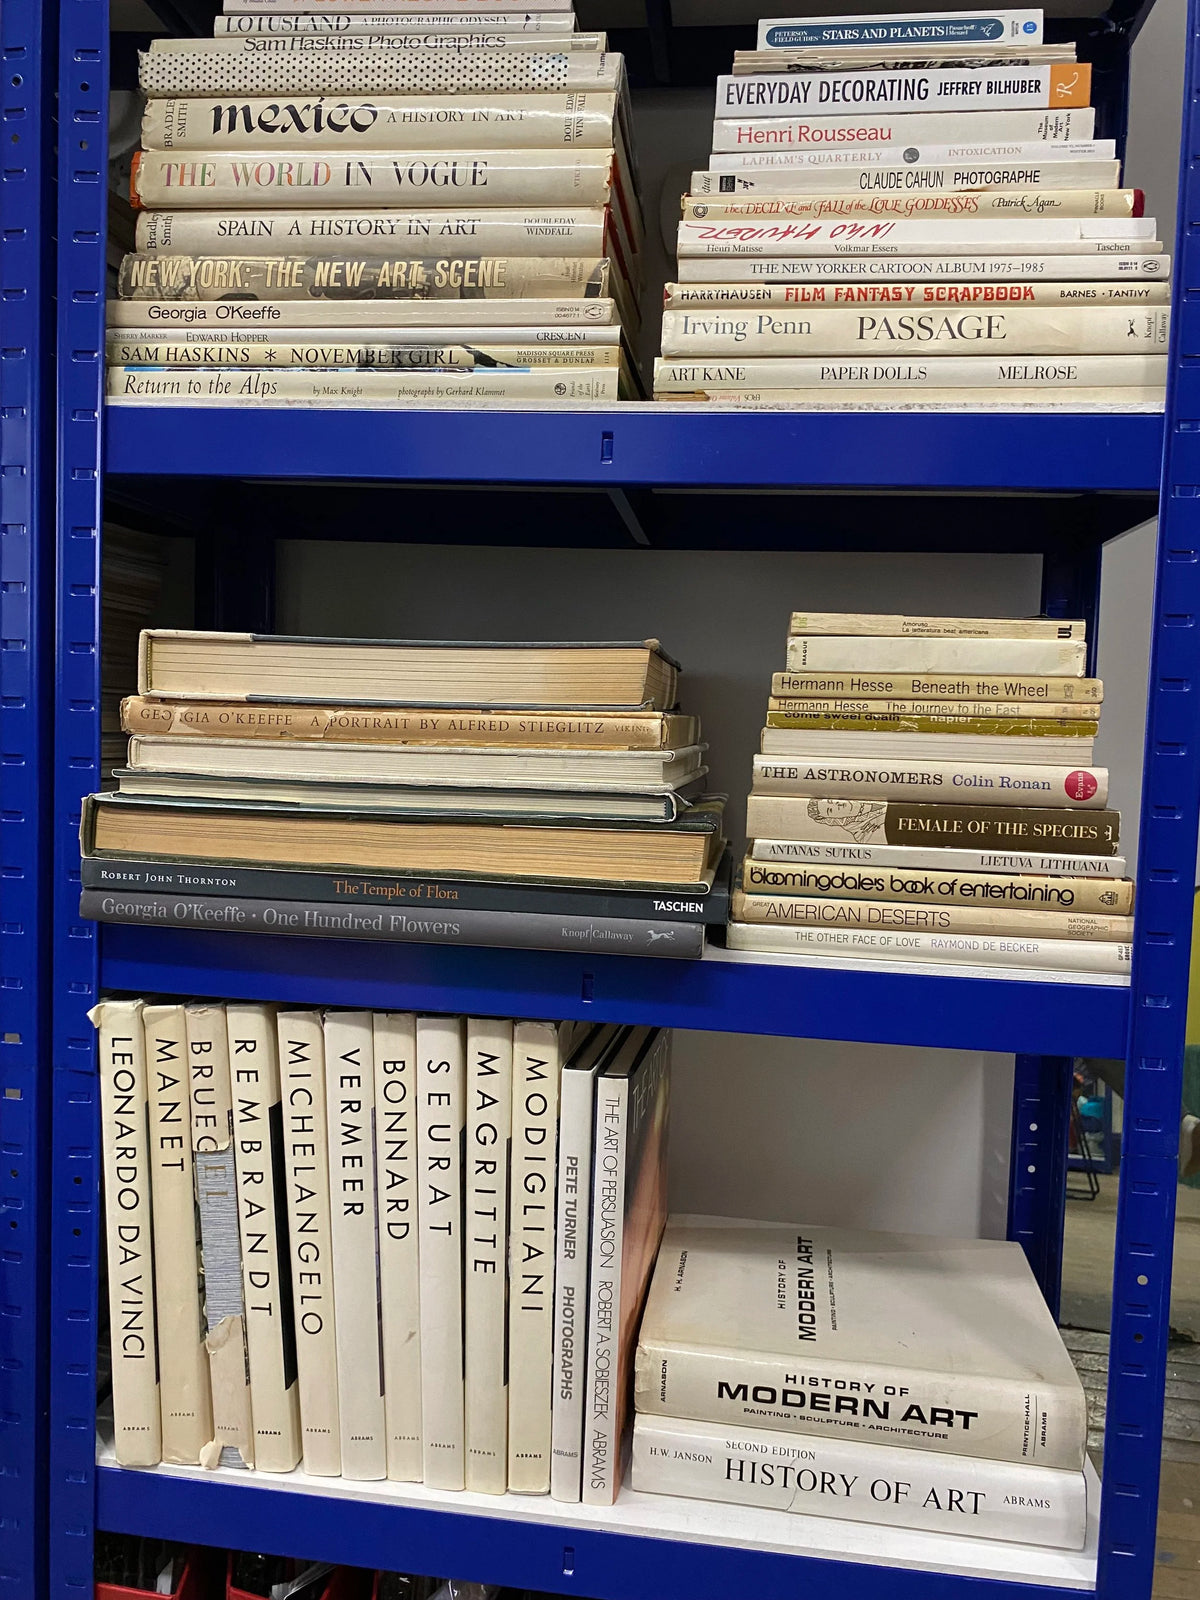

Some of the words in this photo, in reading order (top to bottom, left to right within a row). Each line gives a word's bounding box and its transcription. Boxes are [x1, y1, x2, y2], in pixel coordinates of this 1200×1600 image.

[822, 29, 859, 41] STARS
[861, 28, 887, 39] AND
[889, 26, 945, 38] PLANETS
[726, 80, 811, 105] EVERYDAY
[818, 78, 929, 103] DECORATING
[937, 80, 983, 96] JEFFREY
[986, 79, 1041, 95] BILHUBER
[737, 126, 793, 144] Henri
[798, 125, 892, 143] Rousseau
[948, 147, 1022, 157] INTOXICATION
[160, 161, 216, 187] THE
[231, 161, 332, 187] WORLD
[344, 160, 374, 187] IN
[392, 160, 488, 187] VOGUE
[859, 171, 903, 190] CLAUDE
[905, 171, 944, 189] CAHUN
[953, 170, 1041, 185] PHOTOGRAPHE
[834, 244, 870, 253] Volkmar
[872, 244, 898, 253] Essers
[1095, 243, 1130, 252] Taschen
[130, 260, 182, 287] NEW
[188, 260, 251, 288] YORK:
[264, 260, 307, 288] THE
[314, 260, 367, 288] NEW
[377, 260, 424, 288] ART
[434, 259, 508, 288] SCENE
[681, 289, 772, 300] HARRYHAUSEN
[785, 287, 826, 302] FILM
[834, 286, 916, 302] FANTASY
[923, 286, 1035, 303] SCRAPBOOK
[1060, 289, 1097, 298] BARNES
[1109, 288, 1150, 298] TANTIVY
[148, 305, 207, 322] Georgia
[215, 304, 281, 320] O'Keeffe
[186, 332, 228, 343] EDWARD
[230, 332, 270, 344] HOPPER
[682, 315, 748, 342] Irving
[756, 315, 812, 335] Penn
[856, 315, 1007, 341] PASSAGE
[121, 347, 160, 363] SAM
[165, 347, 251, 364] HASKINS
[290, 349, 402, 364] NOVEMBER
[408, 350, 460, 365] GIRL
[123, 374, 182, 395] Return
[187, 377, 202, 394] to
[214, 374, 233, 394] the
[239, 374, 279, 398] Alps
[780, 677, 844, 692] Hermann
[850, 677, 893, 693] Hesse
[911, 679, 971, 695] Beneath
[976, 680, 999, 695] the
[1004, 682, 1049, 697] Wheel
[219, 711, 293, 726] O'KEEFFE
[310, 716, 320, 727] A
[329, 716, 410, 730] PORTRAIT
[419, 719, 440, 731] BY
[448, 719, 510, 732] ALFRED
[519, 720, 605, 734] STIEGLITZ
[761, 766, 798, 778] THE
[803, 768, 944, 786] ASTRONOMERS
[952, 774, 994, 788] Colin
[998, 776, 1052, 791] Ronan
[1075, 772, 1084, 799] Evans
[898, 817, 962, 833] FEMALE
[967, 820, 991, 833] OF
[994, 821, 1028, 836] THE
[1033, 823, 1098, 839] SPECIES
[769, 845, 820, 857] ANTANAS
[825, 847, 872, 860] SUTKUS
[980, 855, 1033, 868] LIETUVA
[1040, 858, 1110, 872] LITHUANIA
[100, 870, 141, 881] ROBERT
[145, 872, 173, 883] JOHN
[177, 874, 237, 887] THORNTON
[333, 880, 359, 894] The
[361, 881, 406, 900] Temple
[409, 885, 424, 898] of
[426, 885, 459, 900] Flora
[890, 874, 934, 895] book
[938, 878, 958, 896] of
[960, 882, 1075, 907] entertaining
[102, 898, 167, 920] Georgia
[263, 908, 299, 926] One
[303, 910, 383, 931] Hundred
[389, 915, 461, 936] Flowers
[653, 900, 704, 913] TASCHEN
[766, 902, 861, 923] AMERICAN
[868, 907, 950, 928] DESERTS
[561, 927, 589, 939] Knopf
[592, 929, 634, 942] Callaway
[795, 931, 814, 941] THE
[816, 932, 849, 943] OTHER
[852, 934, 877, 945] FACE
[879, 936, 893, 946] OF
[895, 937, 921, 948] LOVE
[931, 939, 980, 950] RAYMOND
[983, 941, 996, 951] DE
[999, 942, 1039, 953] BECKER
[155, 1038, 184, 1172] MANET
[604, 1097, 620, 1124] THE
[111, 1037, 140, 1211] LEONARDO
[339, 1047, 364, 1216] VERMEER
[383, 1060, 410, 1240] BONNARD
[427, 1059, 452, 1236] SEURAT
[603, 1126, 619, 1154] ART
[474, 1051, 501, 1274] MAGRITTE
[565, 1156, 578, 1194] PETE
[602, 1155, 618, 1177] OF
[234, 1039, 272, 1316] REMBRANDT
[287, 1040, 323, 1335] MICHELANGELO
[521, 1056, 549, 1311] MODIGLIANI
[563, 1199, 577, 1260] TURNER
[600, 1180, 617, 1269] PERSUASION
[118, 1225, 142, 1266] DA
[797, 1236, 813, 1264] ART
[778, 1259, 787, 1271] OF
[778, 1272, 786, 1309] HISTORY
[121, 1274, 145, 1359] VINCI
[598, 1280, 613, 1331] ROBERT
[798, 1266, 817, 1342] MODERN
[560, 1286, 575, 1400] PHOTOGRAPHS
[593, 1347, 611, 1420] SOBIESZEK
[785, 1374, 876, 1393] HISTORY
[884, 1385, 909, 1397] OF
[718, 1381, 889, 1420] MODERN
[900, 1404, 979, 1430] ART
[744, 1408, 790, 1418] PAINTING
[800, 1415, 860, 1428] SCULPTURE
[868, 1424, 949, 1440] ARCHITECTURE
[1022, 1394, 1030, 1457] PRENTICE-HALL
[1040, 1412, 1048, 1447] ABRAMS
[552, 1448, 578, 1458] ABRAMS
[590, 1429, 607, 1490] ABRAMS
[650, 1447, 671, 1458] H.W.
[674, 1451, 713, 1464] JANSON
[726, 1440, 768, 1454] SECOND
[772, 1446, 816, 1460] EDITION
[725, 1458, 858, 1498] HISTORY
[870, 1479, 911, 1504] OF
[922, 1487, 986, 1515] ART
[1003, 1495, 1051, 1509] ABRAMS
